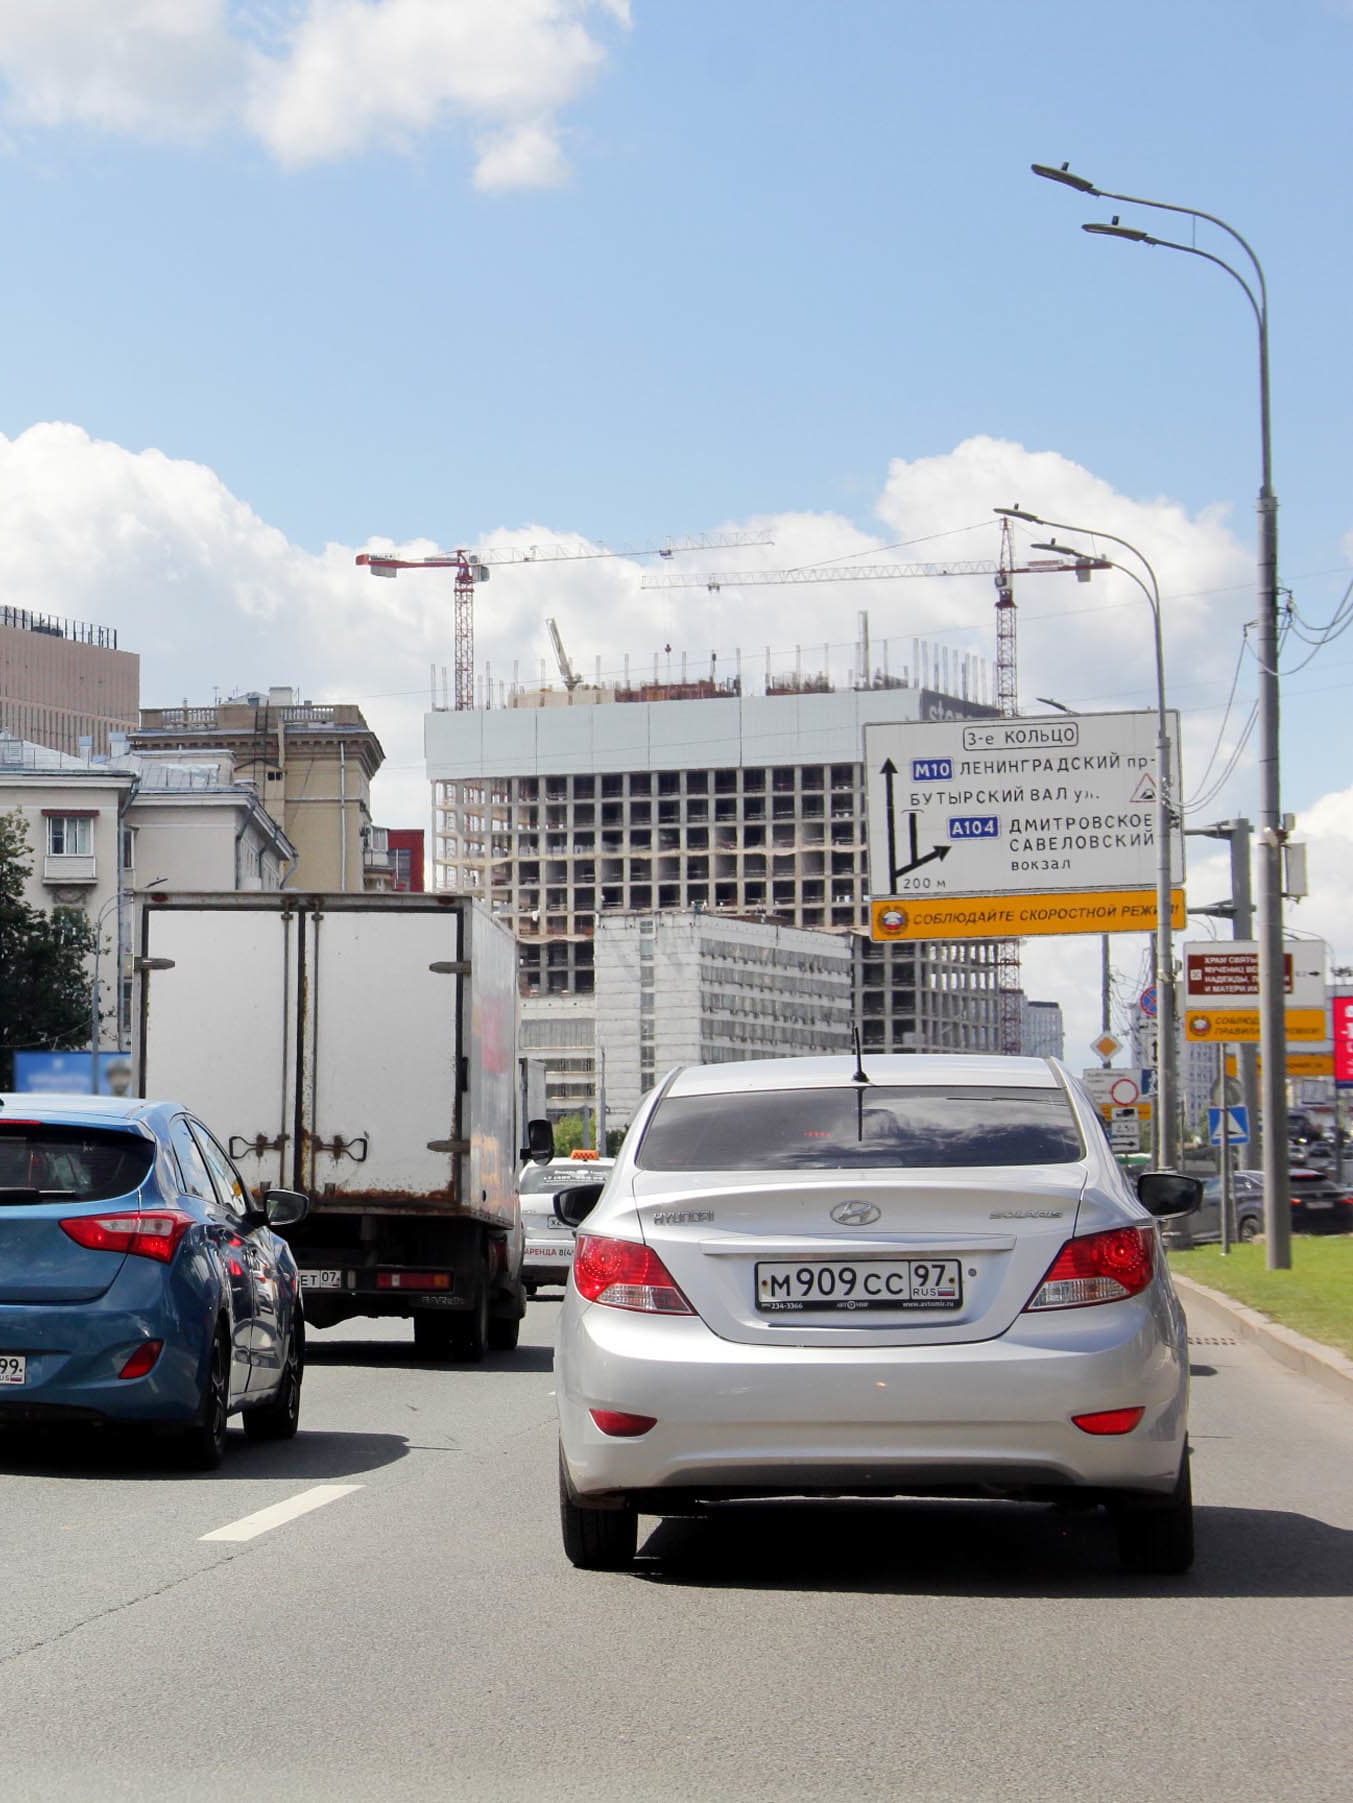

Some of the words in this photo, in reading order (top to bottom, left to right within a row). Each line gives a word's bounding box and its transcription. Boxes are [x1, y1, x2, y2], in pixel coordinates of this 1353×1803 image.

[967, 733, 994, 746] 3-е
[1004, 728, 1075, 744] КОЛЬЦО
[914, 763, 951, 779] М10
[959, 752, 1121, 775] ЛЕНИНГРАДСКИЙ
[1127, 757, 1157, 770] пр-
[910, 786, 1024, 806] БУТЫРСКИЙ
[1030, 787, 1068, 801] ВАЛ
[951, 819, 996, 836] А104
[1009, 814, 1153, 834] ДМИТРОВСКОЕ
[1009, 830, 1155, 852] САВЕЛОВСКИЙ
[1011, 858, 1071, 871] вокзал
[903, 878, 931, 889] 200
[937, 880, 946, 888] м
[913, 908, 1015, 926] СОБЛЮДАЙТЕ
[1020, 903, 1117, 921] СКОРОСТНОЙ
[524, 1247, 557, 1256] АРЕНДА
[321, 1271, 336, 1282] 07
[914, 1264, 946, 1287] 97
[912, 1287, 937, 1297] RUS
